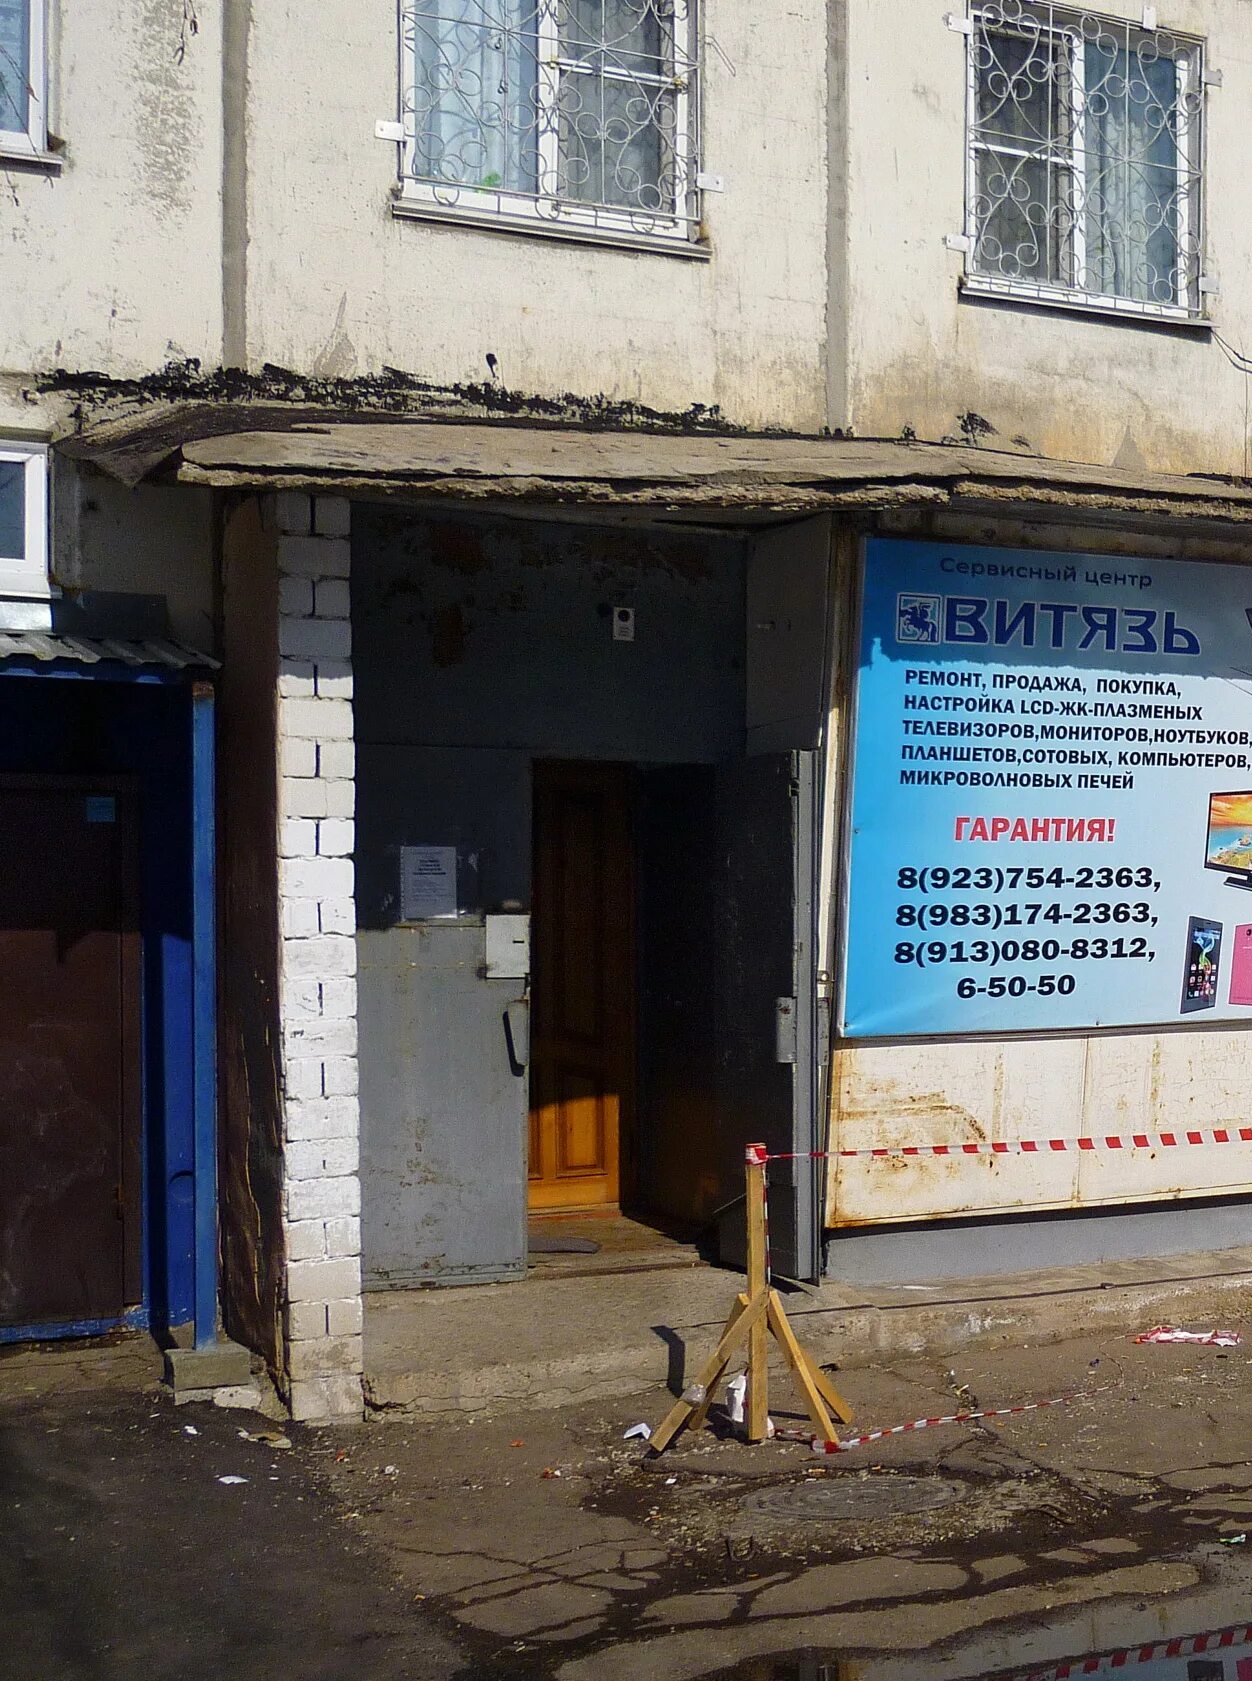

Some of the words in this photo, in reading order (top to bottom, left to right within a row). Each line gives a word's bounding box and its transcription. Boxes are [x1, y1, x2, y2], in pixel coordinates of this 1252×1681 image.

[940, 557, 1076, 582] Сервисный
[1085, 570, 1152, 590] центр
[944, 595, 1201, 656] ВИТЯЗЬ
[905, 669, 986, 691] РЕМОНТ,
[992, 674, 1087, 695] ПРОДАЖА,
[1096, 678, 1181, 699] ПОКУПКА,
[904, 693, 1015, 714] НАСТРОЙКА
[1021, 700, 1203, 720] LCD-ЖК-ПЛАЗМЕНЫХ
[1118, 751, 1251, 771] КОМПЬЮТЕРОВ,
[899, 769, 1073, 789] МИКРОВОЛНОВЫХ
[1078, 771, 1134, 789] ПЕЧЕЙ
[954, 816, 1116, 842] ГАРАНТИЯ!
[897, 867, 1161, 894] 8(923)754-2363,
[895, 902, 1159, 930] 8(983)174-2363,
[894, 938, 1156, 968] 8(913)080-8312,
[957, 974, 1076, 999] 6-50-50
